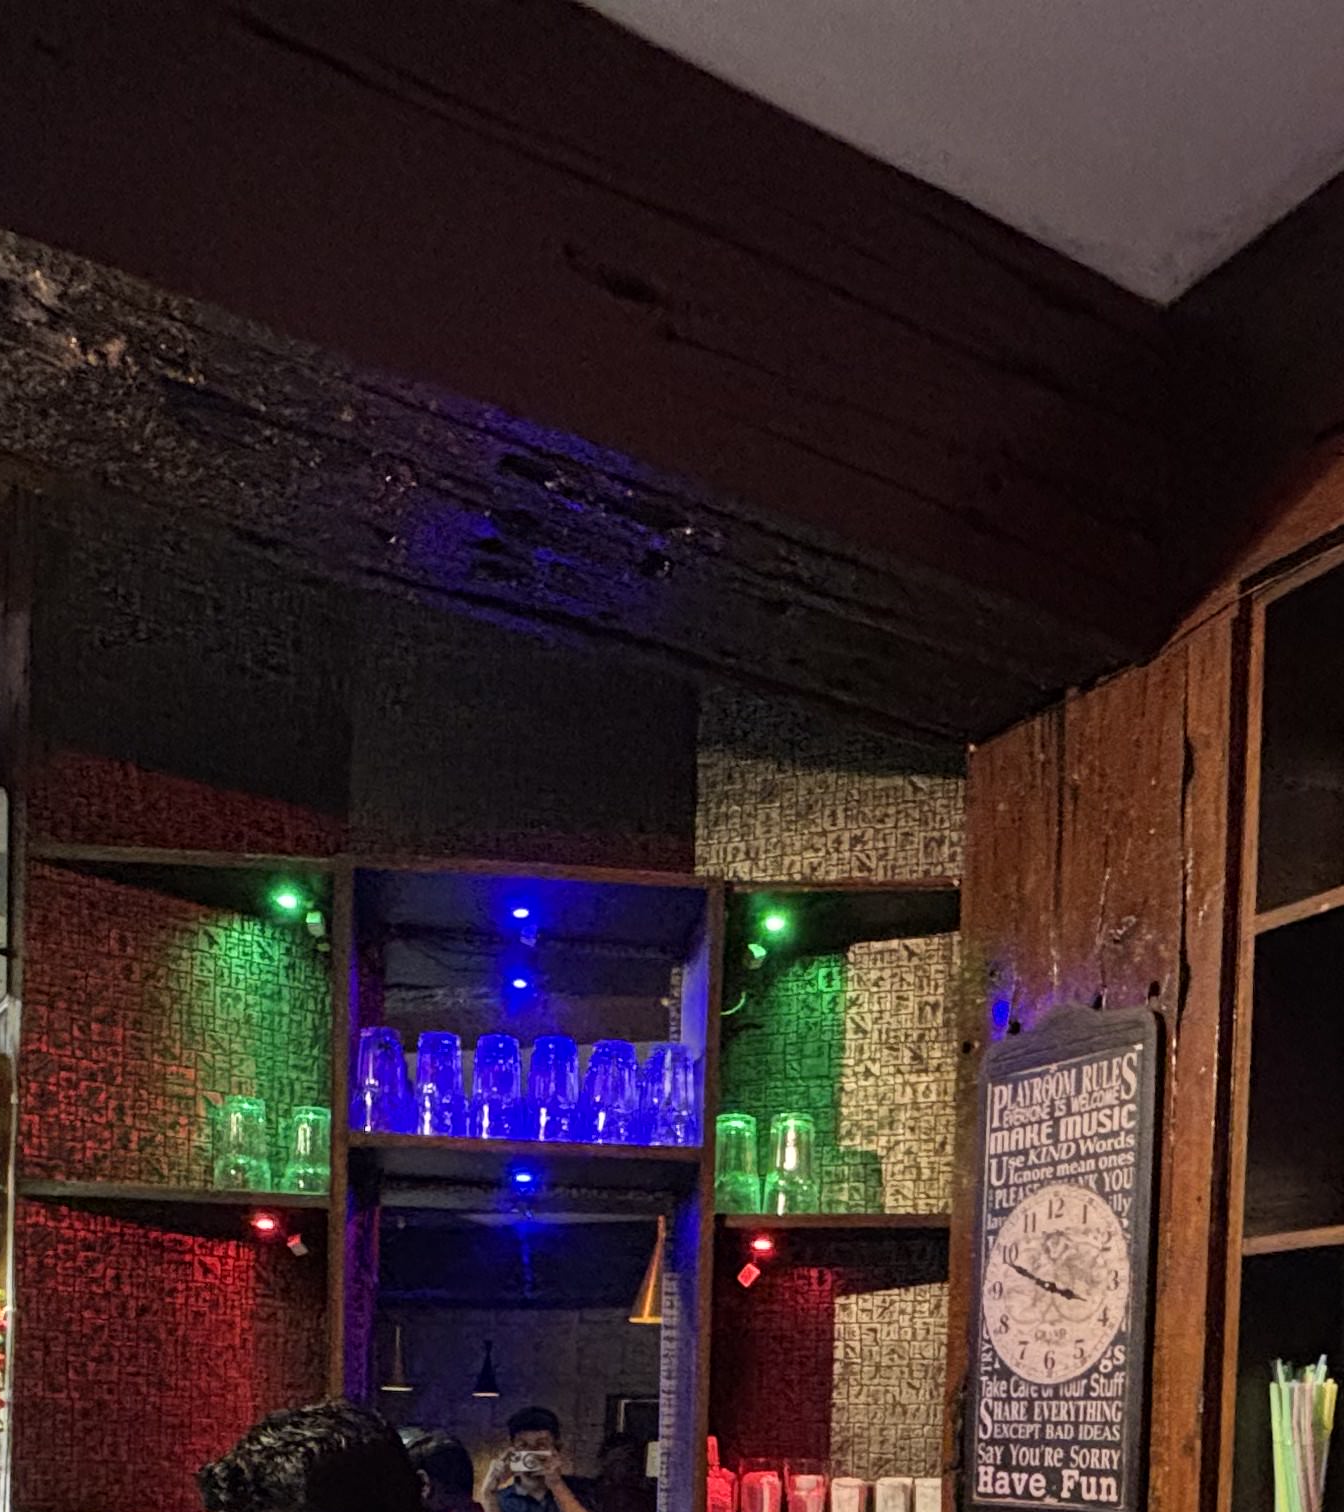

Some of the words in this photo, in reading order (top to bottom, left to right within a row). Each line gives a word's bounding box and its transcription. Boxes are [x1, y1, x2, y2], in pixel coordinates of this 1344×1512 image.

[992, 1069, 1076, 1128] PLAYROOM
[1082, 1052, 1138, 1100] RULES
[1055, 1098, 1067, 1117] IS
[1072, 1087, 1121, 1112] WELCOME
[990, 1121, 1053, 1155] MAKE
[1059, 1103, 1137, 1141] MUSIC
[990, 1155, 1025, 1187] Use
[1027, 1141, 1076, 1166] KIND
[1079, 1132, 1136, 1156] Words
[1056, 1158, 1096, 1177] mean
[1098, 1151, 1135, 1168] ones
[1104, 1168, 1134, 1192] YOU
[1047, 1197, 1065, 1220] 12
[1081, 1203, 1088, 1225] 1
[1023, 1211, 1037, 1234] 11
[991, 1280, 1004, 1300] 9
[1107, 1269, 1119, 1292] 3
[998, 1313, 1010, 1335] 8
[1018, 1340, 1030, 1361] 7
[1043, 1349, 1056, 1371] 6
[1073, 1338, 1085, 1360] 5
[981, 1375, 1007, 1398] Take
[1090, 1371, 1125, 1398] Stuff
[979, 1398, 1028, 1440] SHARE
[1033, 1400, 1122, 1422] EVERYTHING
[994, 1422, 1041, 1440] EXCEPT
[1045, 1423, 1074, 1441] BAD
[1078, 1424, 1121, 1441] IDEAS
[977, 1465, 1048, 1497] Have
[1060, 1469, 1119, 1502] Fun
